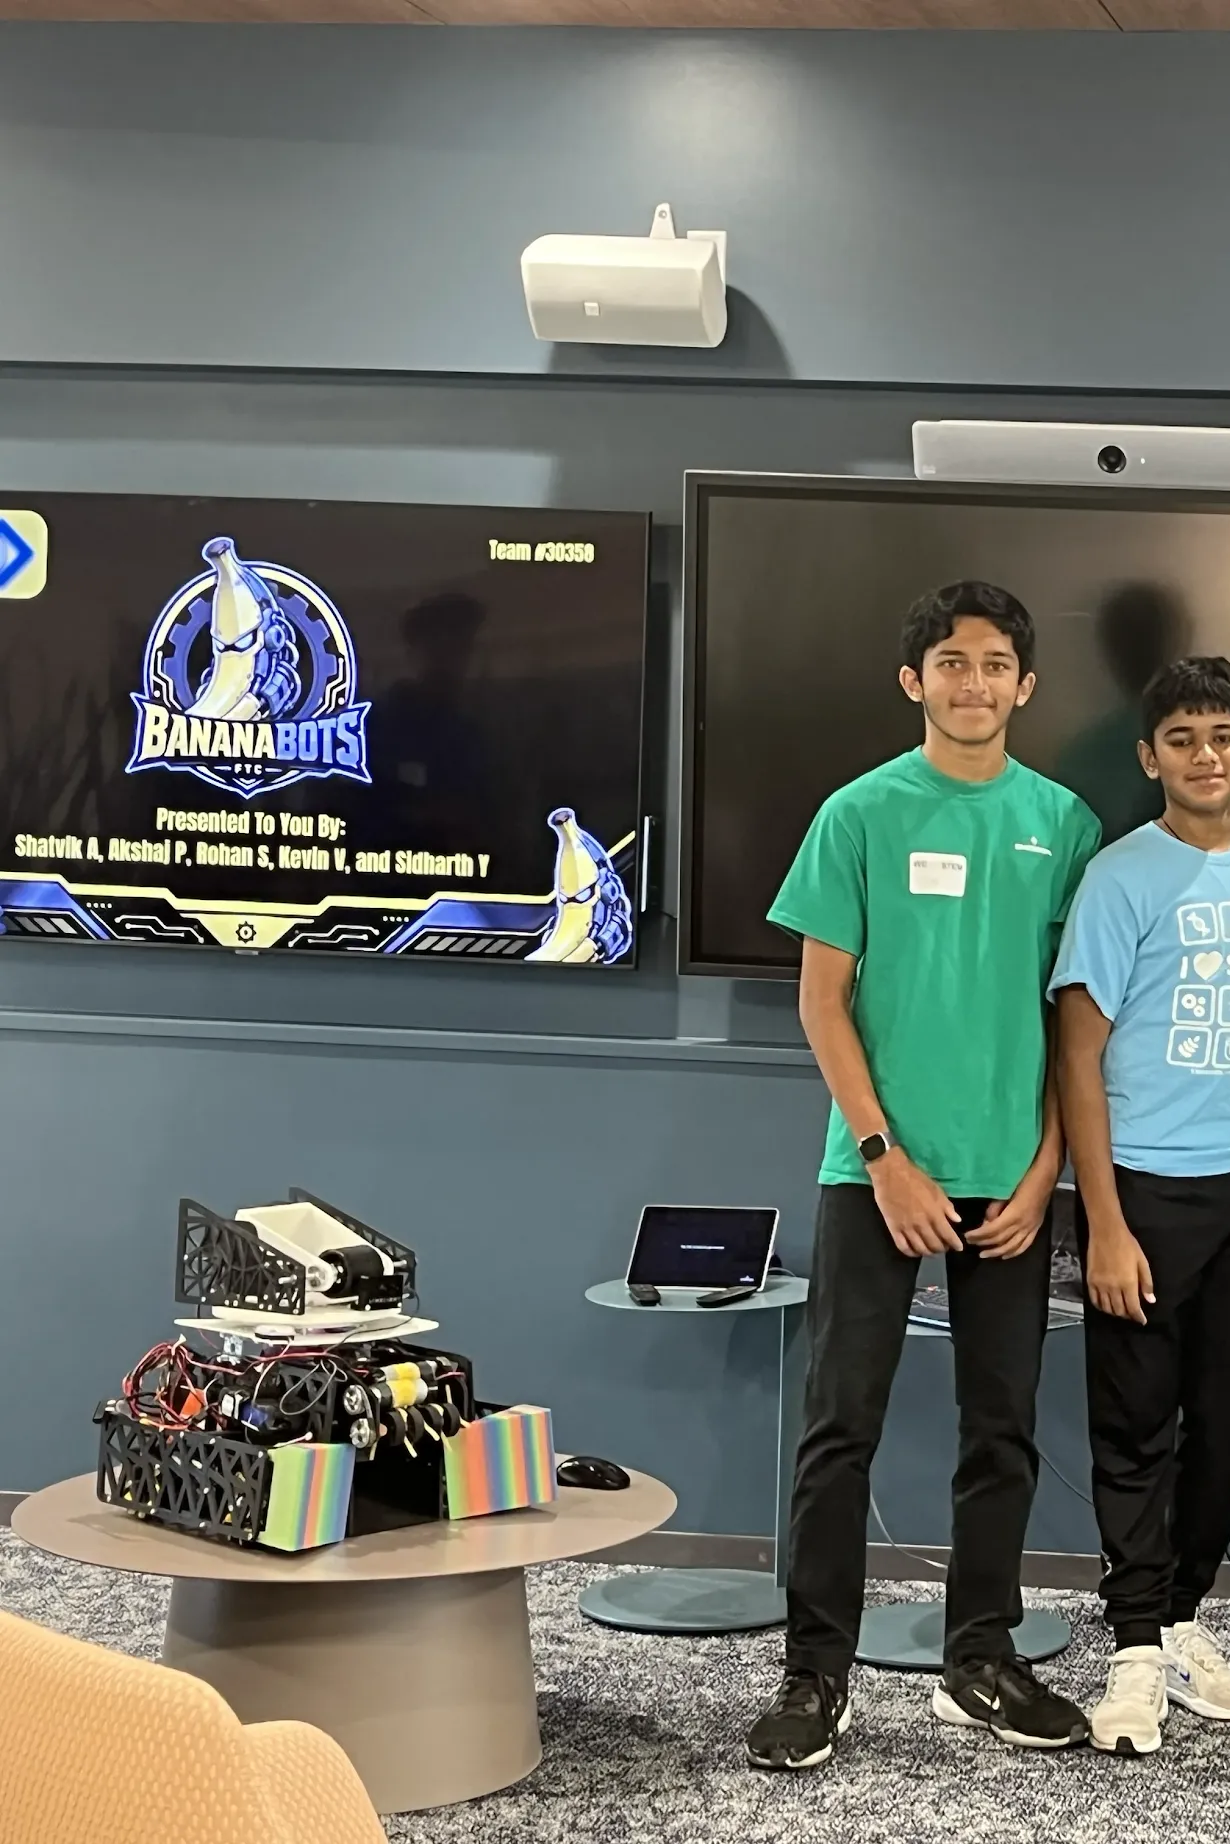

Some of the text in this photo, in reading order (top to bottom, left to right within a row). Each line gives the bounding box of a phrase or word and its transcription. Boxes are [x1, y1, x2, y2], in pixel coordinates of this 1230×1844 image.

[489, 539, 595, 563] Team #30358
[138, 702, 361, 769] BANANABOTS
[234, 764, 262, 775] FTC
[156, 807, 346, 841] Presented To You By:
[14, 833, 83, 859] Shatvik
[87, 836, 104, 863] A,
[108, 838, 171, 865] Akshaj
[196, 841, 254, 867] Rohan
[257, 845, 274, 870] S,
[278, 845, 329, 871] Kevin
[334, 847, 350, 874] V,
[355, 850, 391, 873] and
[395, 850, 474, 877] Sidharth
[477, 854, 490, 878] Y
[1180, 956, 1188, 979] I
